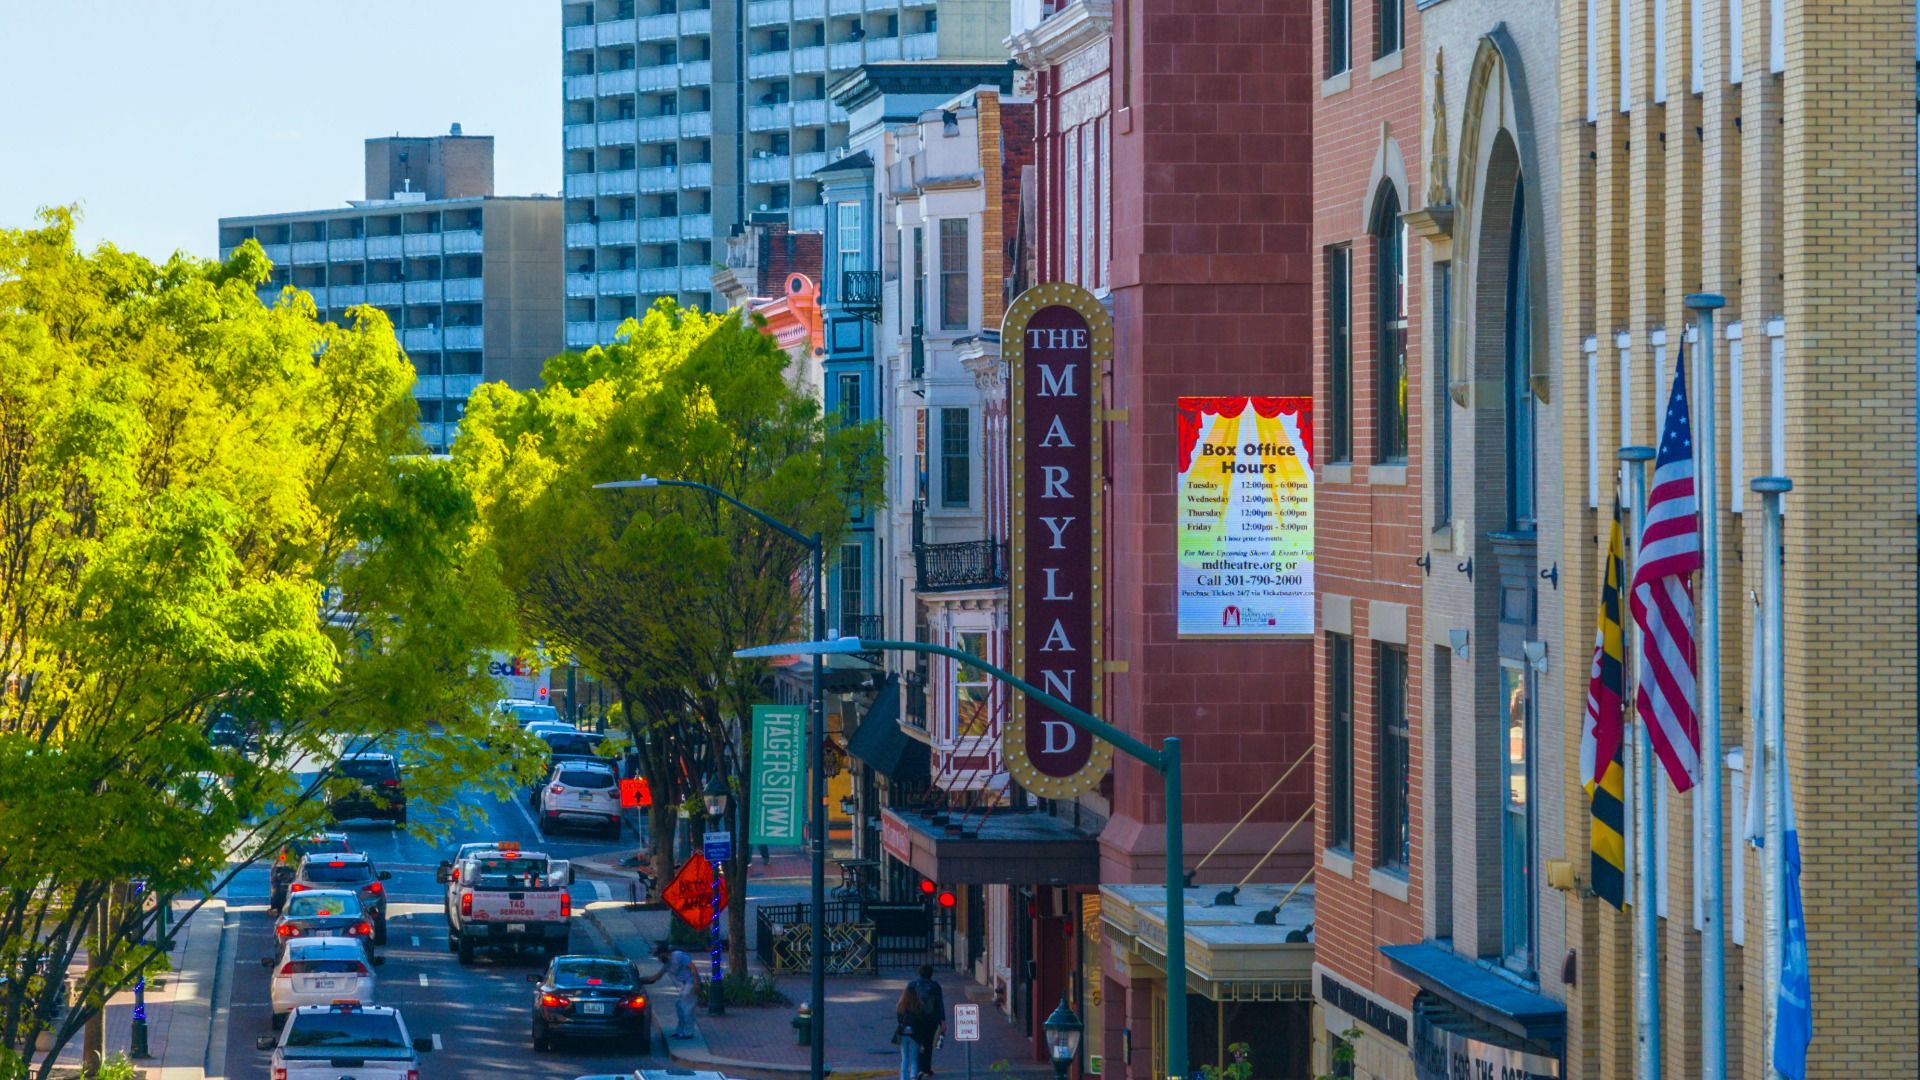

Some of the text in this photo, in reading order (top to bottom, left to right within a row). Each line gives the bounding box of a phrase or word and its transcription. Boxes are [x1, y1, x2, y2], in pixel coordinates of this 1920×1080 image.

[1026, 328, 1088, 349] THE
[1202, 443, 1296, 456] Box Office
[1222, 461, 1276, 474] Hours
[1187, 481, 1219, 492] Tuesday
[1241, 481, 1273, 492] 12:00pm
[1280, 481, 1308, 492] 6:00pm
[1187, 495, 1229, 506] Wednesday
[1241, 495, 1273, 506] 12:00pm
[1280, 495, 1308, 506] 5:00pm
[1187, 509, 1223, 520] Thursday
[1241, 509, 1272, 520] 12:00pm
[1280, 509, 1307, 520] 6:00pm
[1187, 523, 1212, 534] Friday
[1241, 523, 1273, 534] 12:00pm
[1280, 523, 1308, 534] 5:00pm
[1036, 363, 1077, 753] MARYLAND
[1216, 549, 1248, 557] Upcoming
[1202, 559, 1297, 573] mdtheatre.org or
[1197, 574, 1303, 586] Call 301-790-2000
[792, 713, 800, 772] DOWNTOWN
[761, 713, 796, 837] HAGERSTOWN
[1453, 1052, 1471, 1080] FOR
